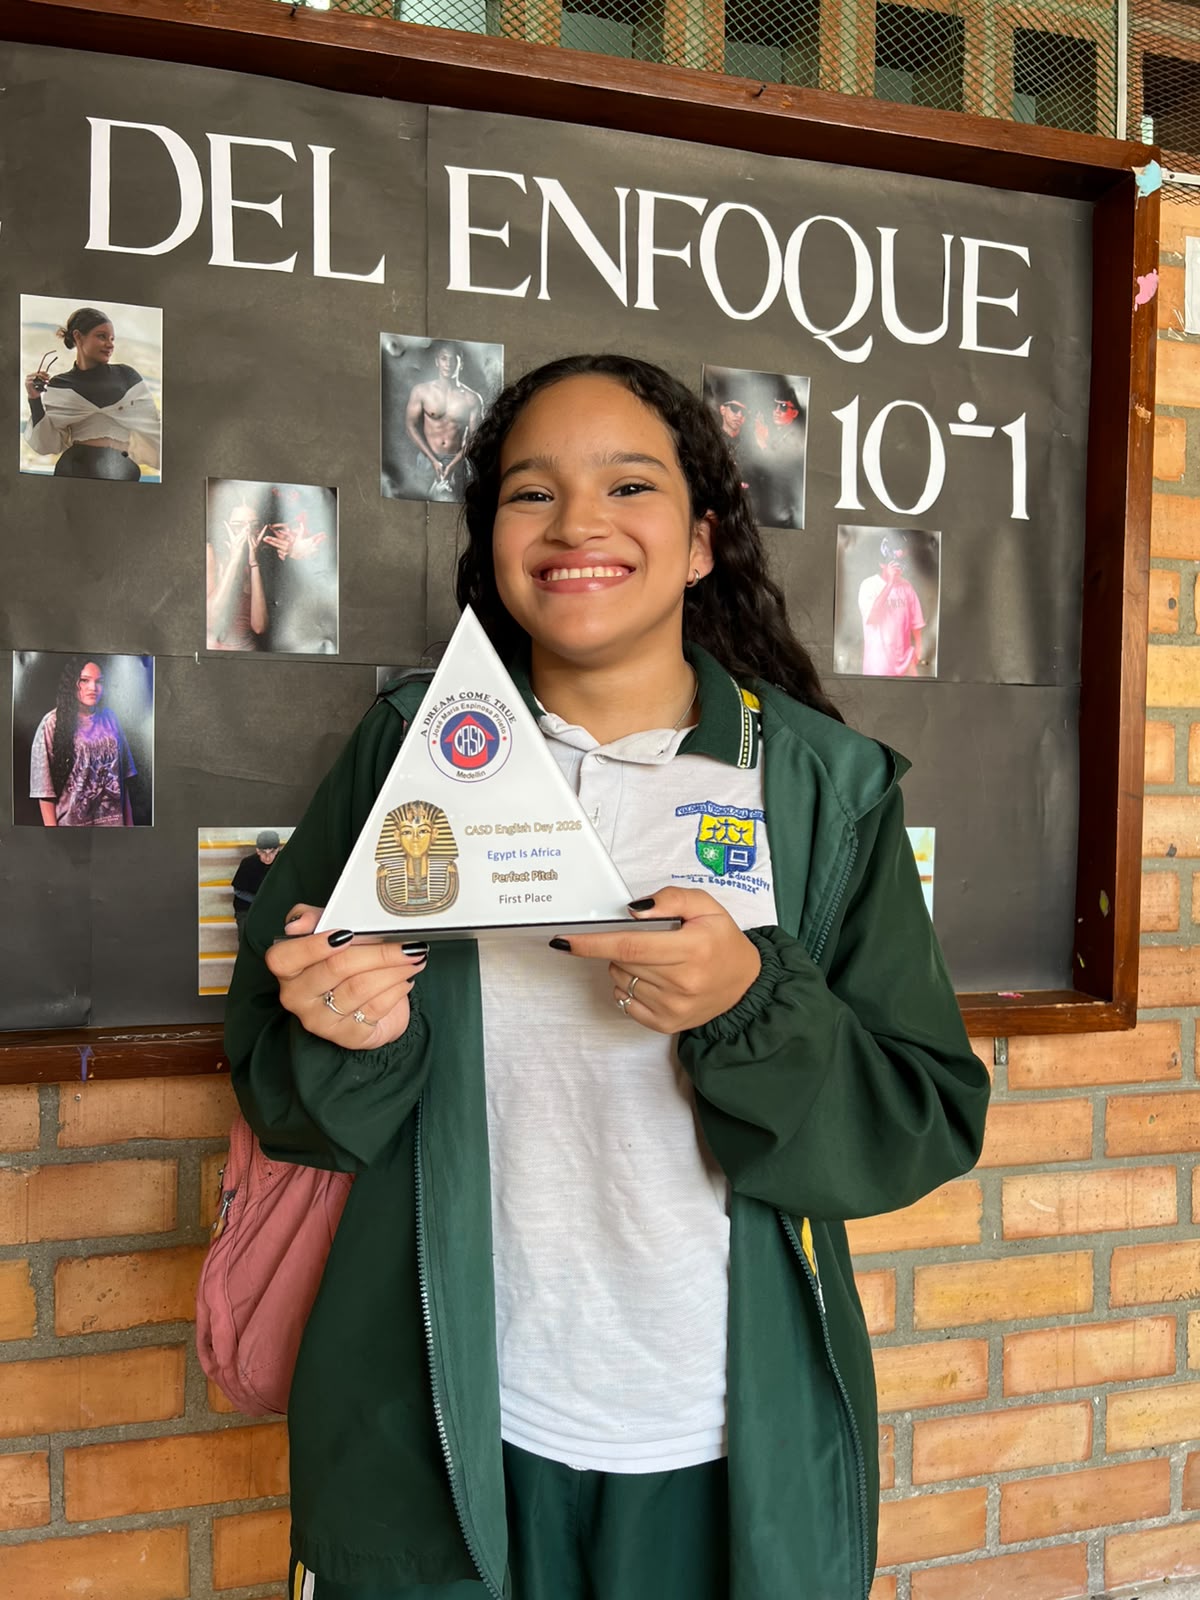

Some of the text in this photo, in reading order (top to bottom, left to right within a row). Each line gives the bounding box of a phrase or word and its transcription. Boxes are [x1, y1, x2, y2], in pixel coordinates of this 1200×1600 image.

[85, 116, 1033, 363] DEL ENFOQUE
[420, 691, 517, 738] A DREAM COME TRUE
[460, 702, 493, 716] Espinosa
[454, 724, 485, 756] CASD
[464, 824, 493, 836] CASD
[494, 822, 531, 836] English
[533, 822, 554, 834] Day
[487, 848, 562, 862] Egypt Is Africa
[492, 868, 558, 884] Perfect Pitch
[499, 893, 552, 904] First Place
